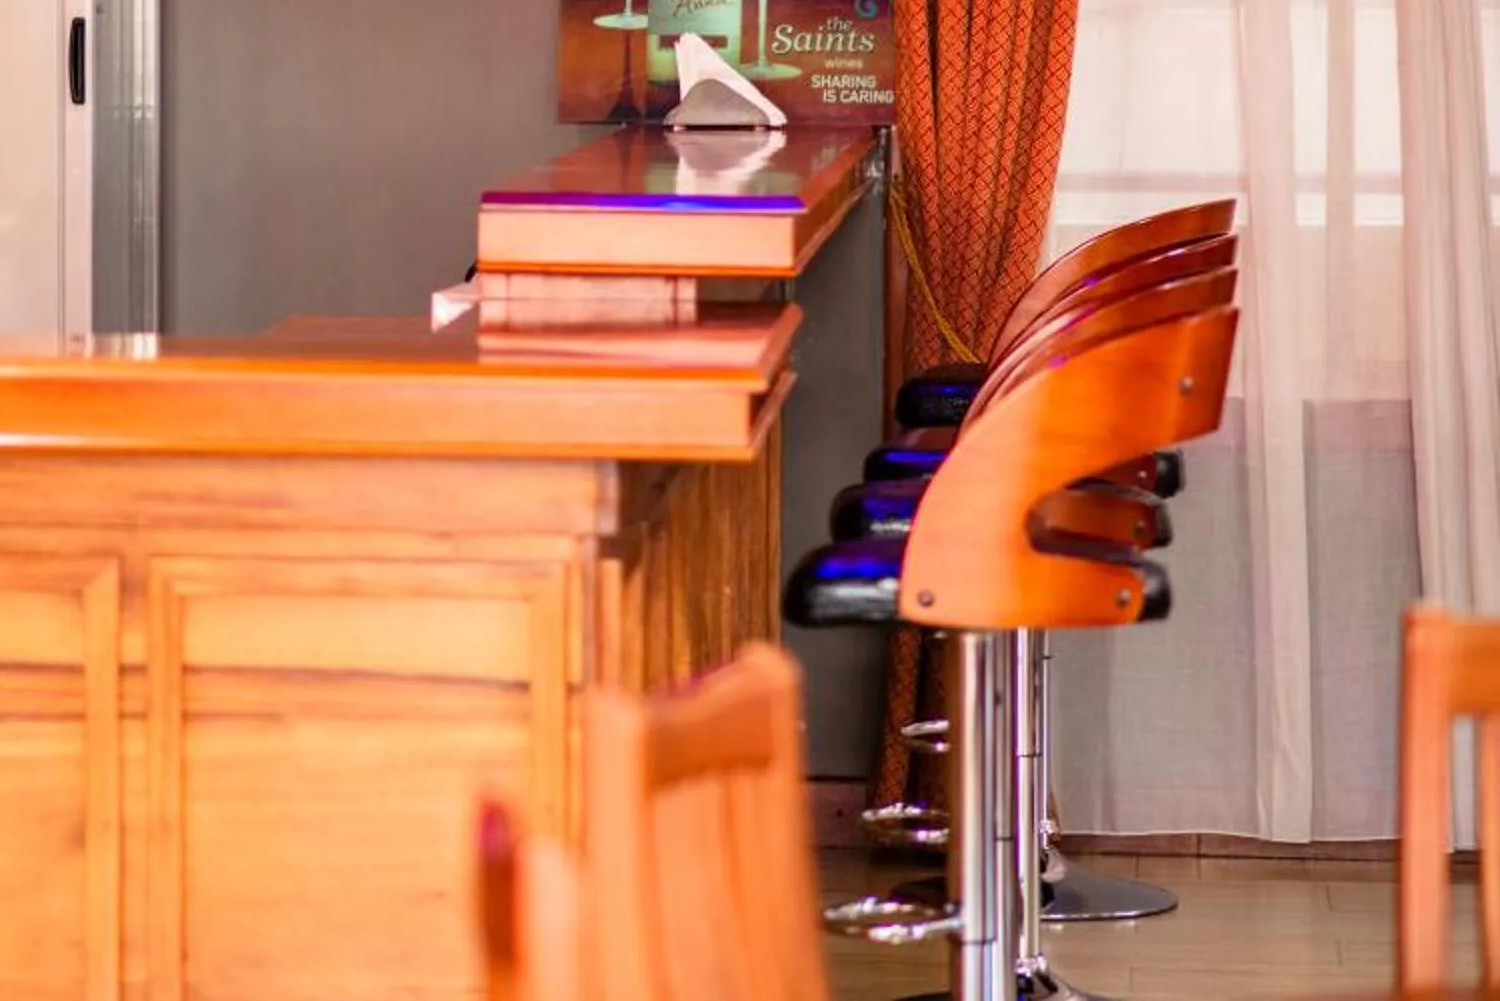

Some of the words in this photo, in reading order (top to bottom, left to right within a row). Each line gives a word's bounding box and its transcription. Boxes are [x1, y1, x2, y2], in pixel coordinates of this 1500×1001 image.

[827, 15, 853, 31] the
[771, 23, 876, 54] Saints
[811, 74, 878, 89] SHARING
[823, 90, 837, 104] IS
[840, 90, 895, 104] CARING
